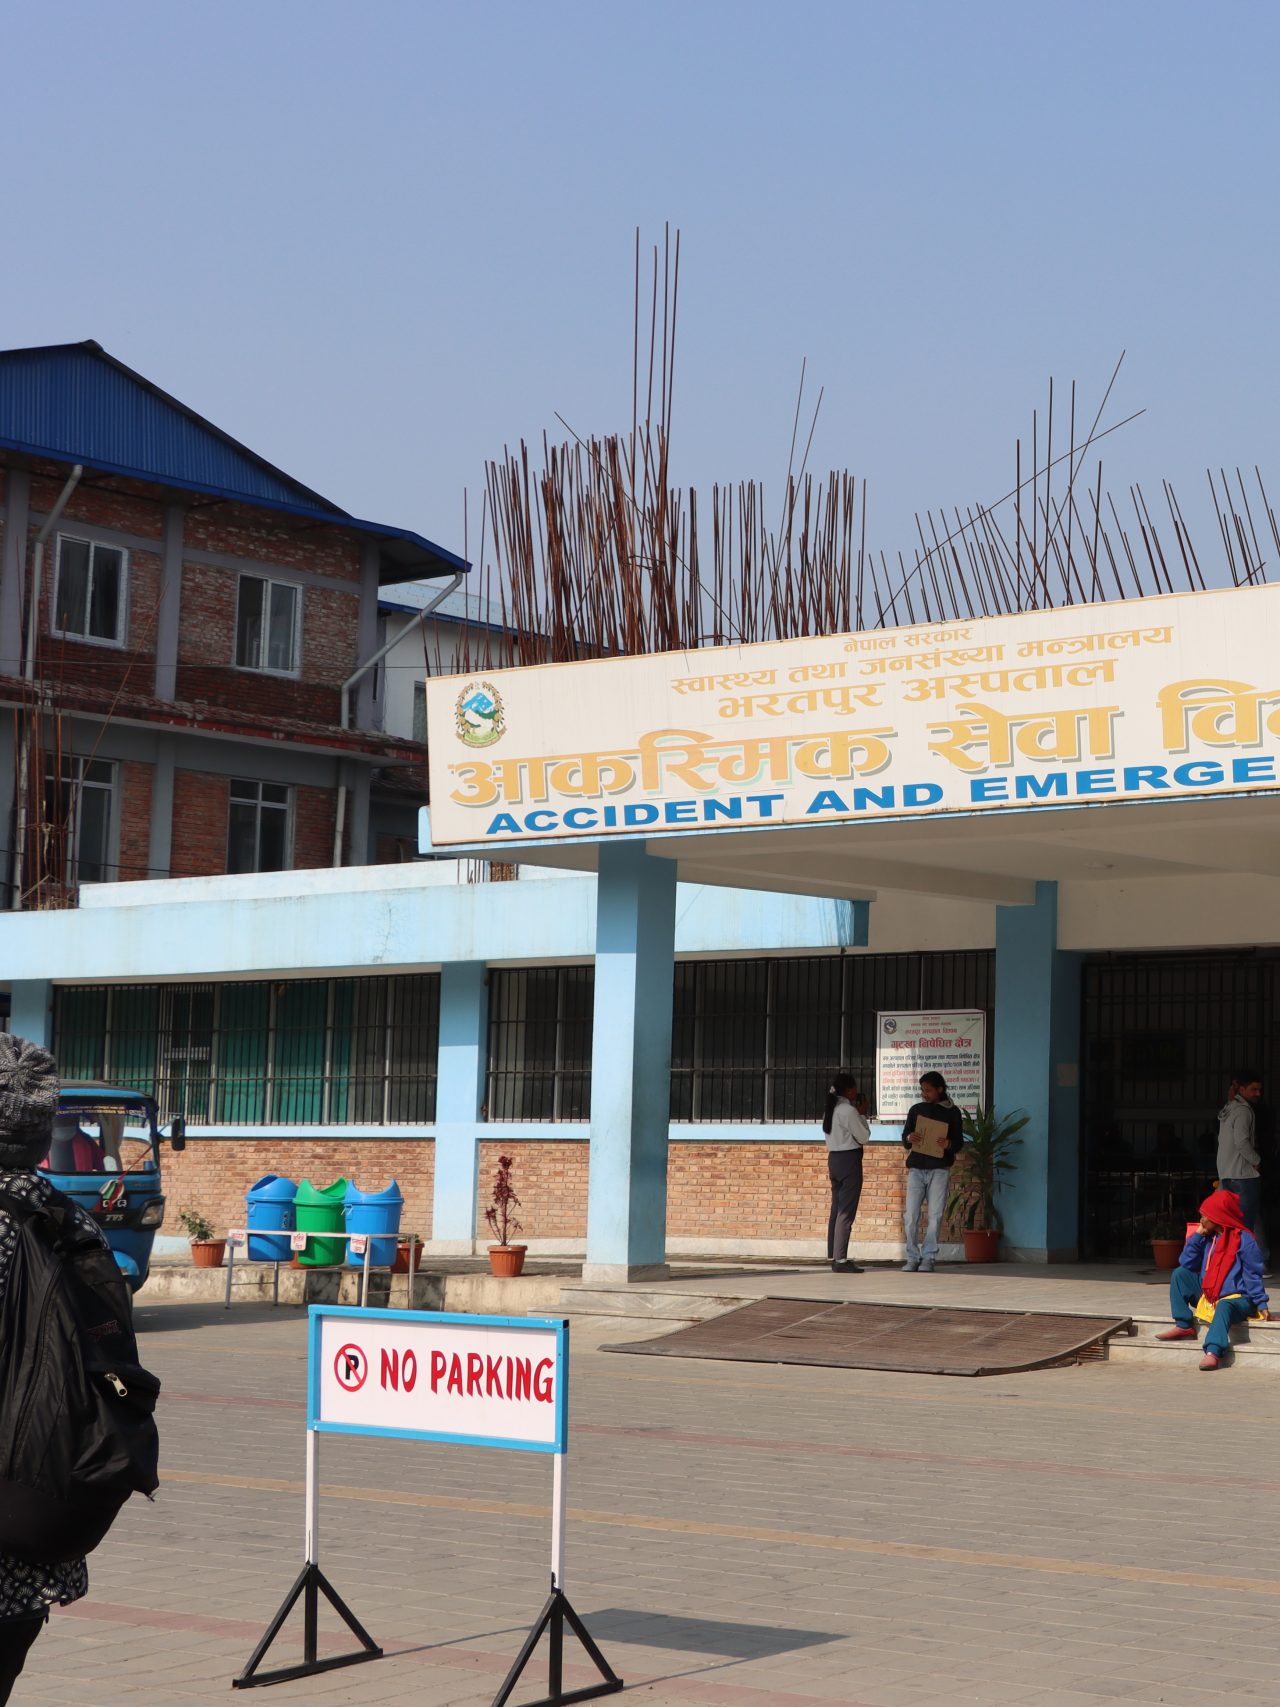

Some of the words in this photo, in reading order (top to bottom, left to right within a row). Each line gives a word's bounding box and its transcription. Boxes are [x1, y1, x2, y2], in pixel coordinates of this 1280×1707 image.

[670, 669, 777, 695] स्वास्थ्य
[788, 661, 847, 684] तथा
[858, 644, 1005, 677] जनसंख्या
[1017, 625, 1175, 658] मन्त्रालय
[844, 635, 896, 653] नेपाल
[904, 627, 974, 647] सरकार
[718, 682, 888, 720] भरतपुर
[901, 658, 1119, 702] अस्पताल
[448, 726, 896, 808] आकस्मिक
[927, 702, 1124, 773] सेवा
[486, 793, 786, 835] ACCIDENT
[806, 782, 944, 814] AND
[380, 1347, 417, 1393] NO
[430, 1350, 556, 1404] PARKING
